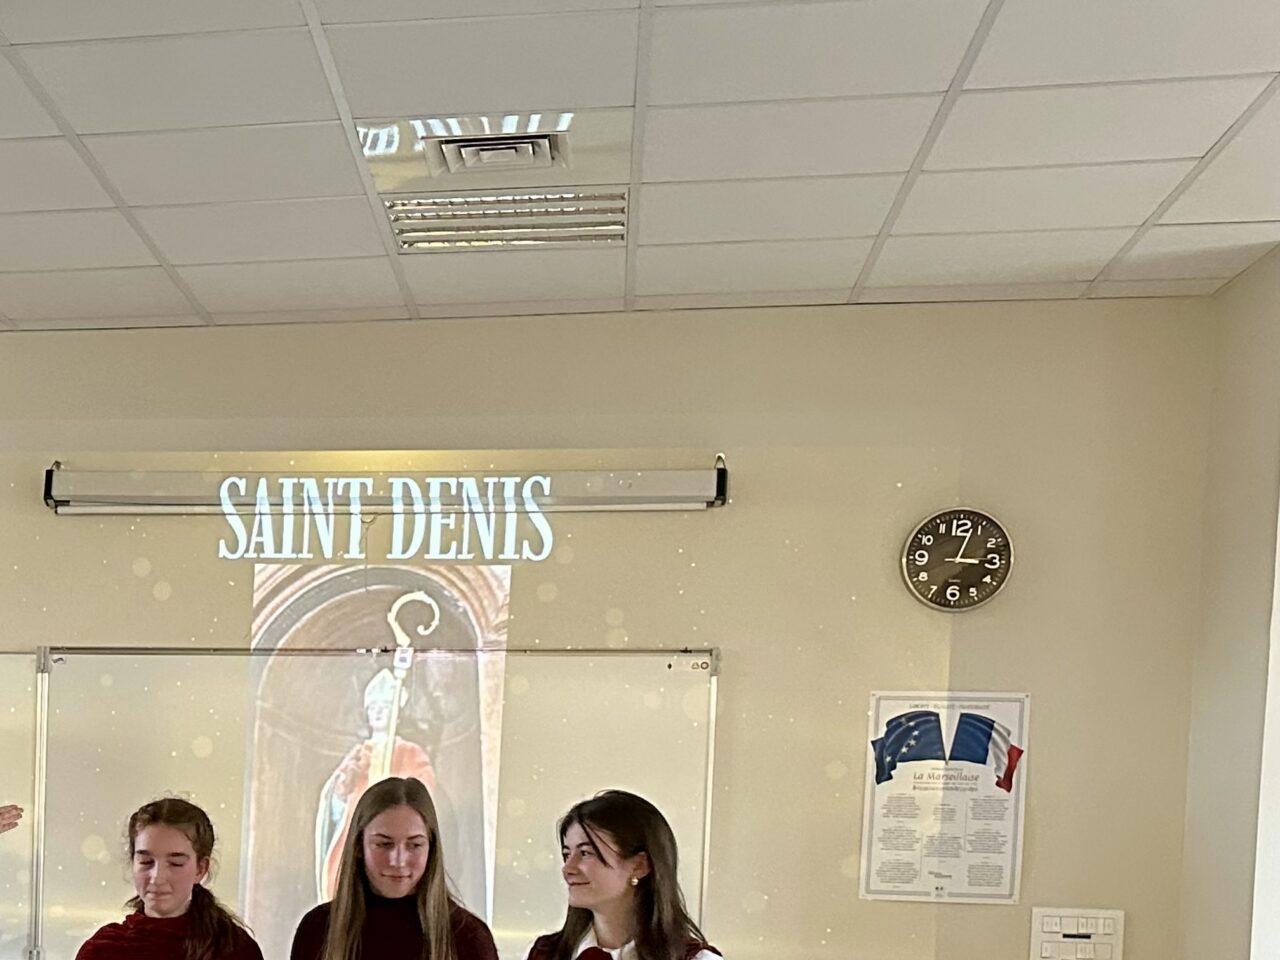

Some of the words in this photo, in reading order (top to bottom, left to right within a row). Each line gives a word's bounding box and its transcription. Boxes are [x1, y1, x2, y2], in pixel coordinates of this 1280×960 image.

[218, 476, 374, 560] SAINT
[386, 475, 554, 562] DENIS
[939, 523, 946, 534] 11
[951, 519, 972, 536] 12
[921, 534, 934, 546] 10
[986, 537, 997, 548] 2
[914, 550, 929, 566] 9
[984, 553, 1000, 569] 3
[918, 571, 929, 582] 8
[982, 574, 992, 584] 4
[927, 585, 938, 598] 7
[946, 585, 960, 601] 6
[969, 587, 978, 597] 5
[913, 772, 924, 780] La
[926, 772, 980, 782] Marseillaise
